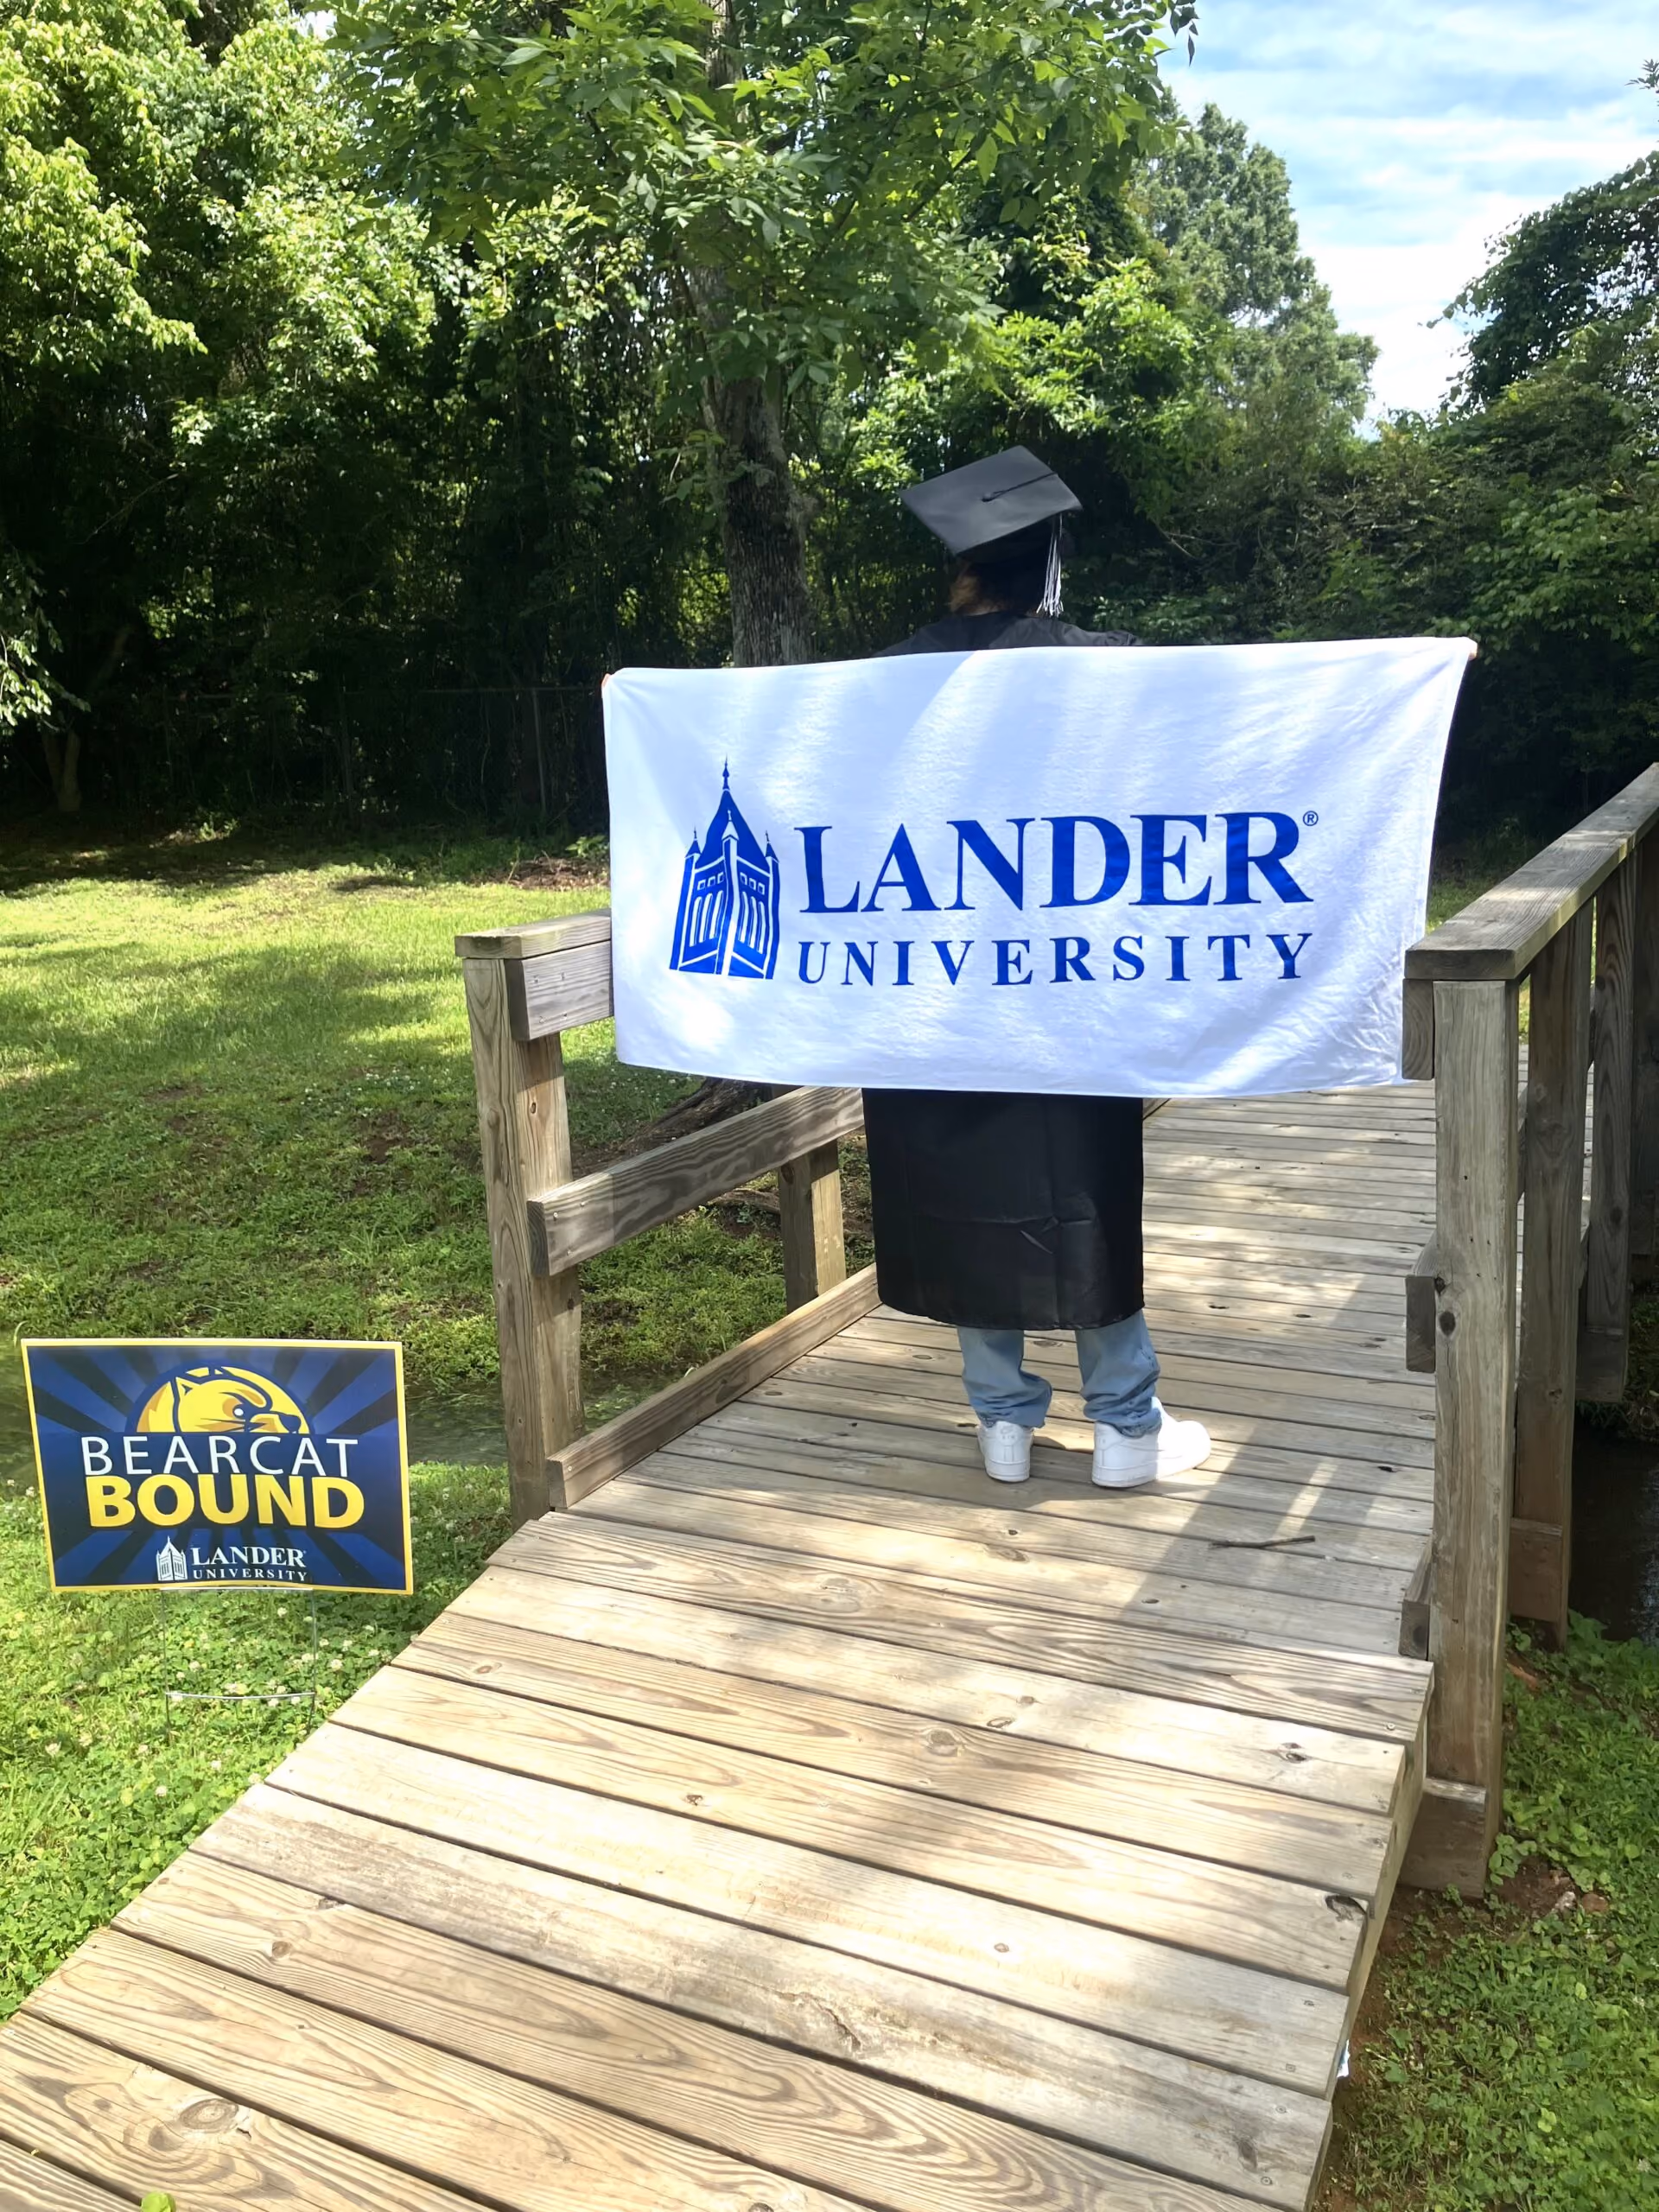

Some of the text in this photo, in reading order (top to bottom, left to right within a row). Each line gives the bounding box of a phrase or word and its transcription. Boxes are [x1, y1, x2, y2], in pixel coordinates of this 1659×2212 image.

[798, 932, 1313, 987] UNIVERSITY
[81, 1435, 359, 1477] BEARCAT
[86, 1473, 365, 1529] BOUND
[190, 1546, 306, 1568] LANDER
[193, 1568, 308, 1582] UNIVERSITY
